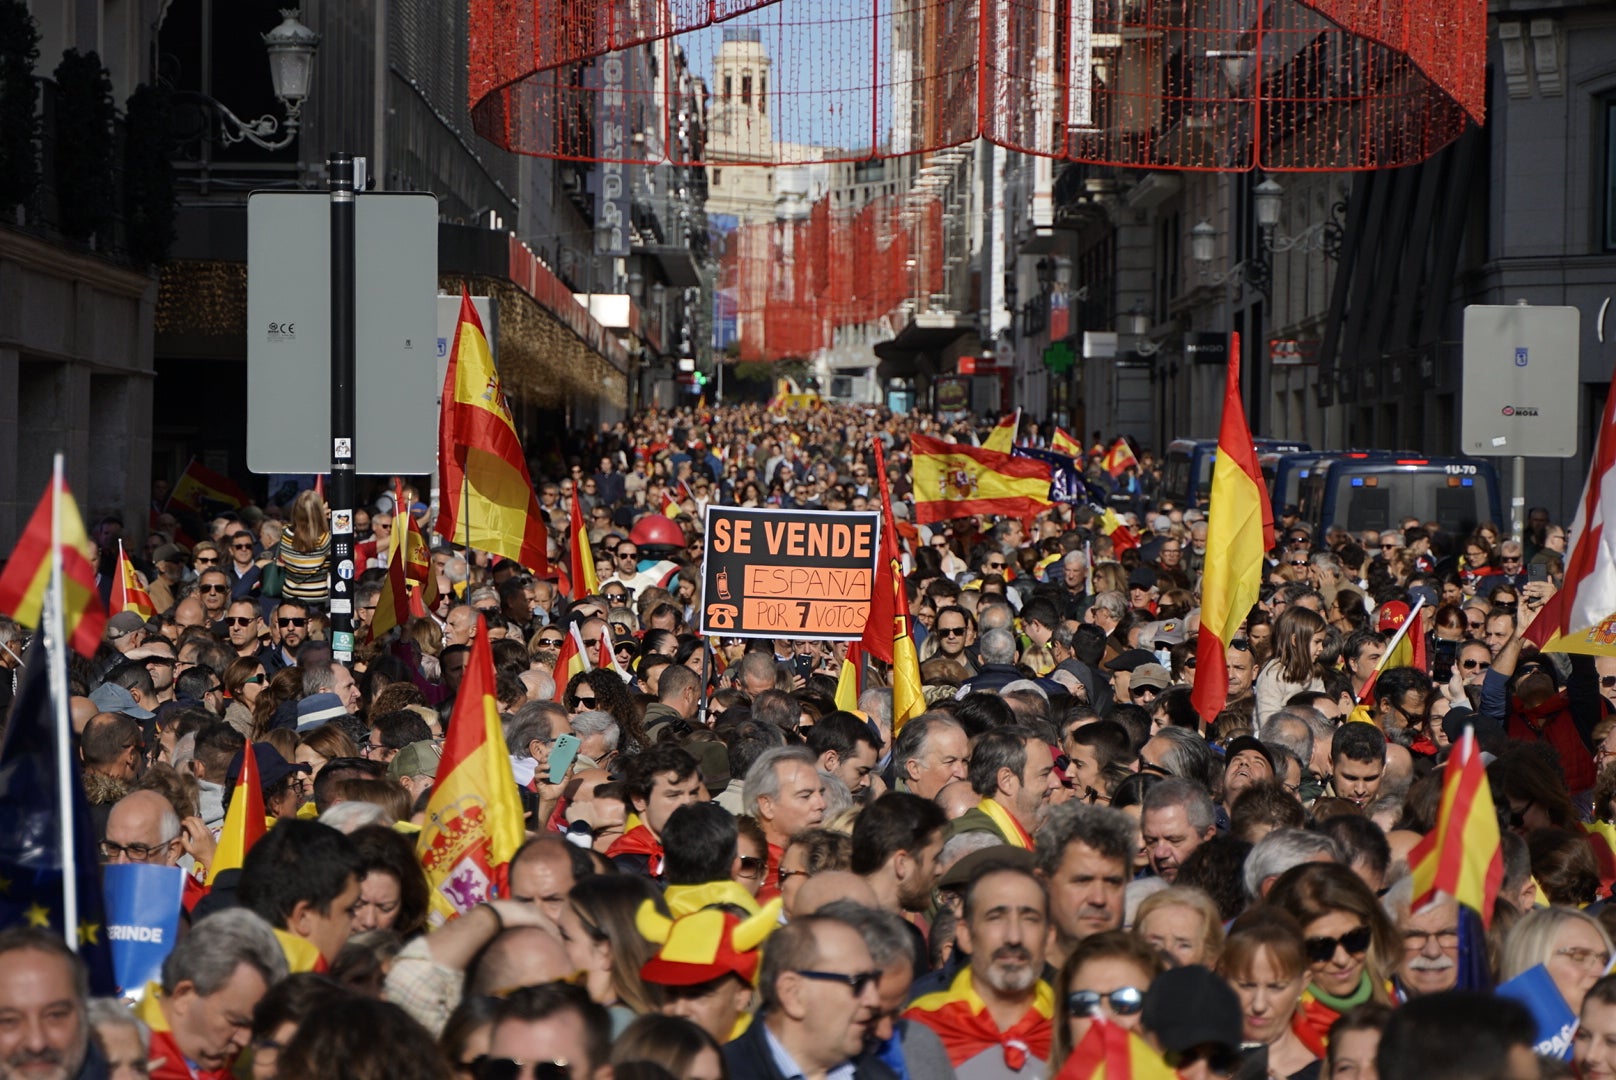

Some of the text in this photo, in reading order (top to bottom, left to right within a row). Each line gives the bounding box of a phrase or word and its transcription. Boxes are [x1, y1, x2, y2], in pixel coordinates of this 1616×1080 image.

[1445, 464, 1477, 475] 1U-70
[713, 518, 871, 558] SE VENDE
[753, 568, 866, 597] ESPAÑA
[757, 601, 868, 628] POR 7 VOTOS
